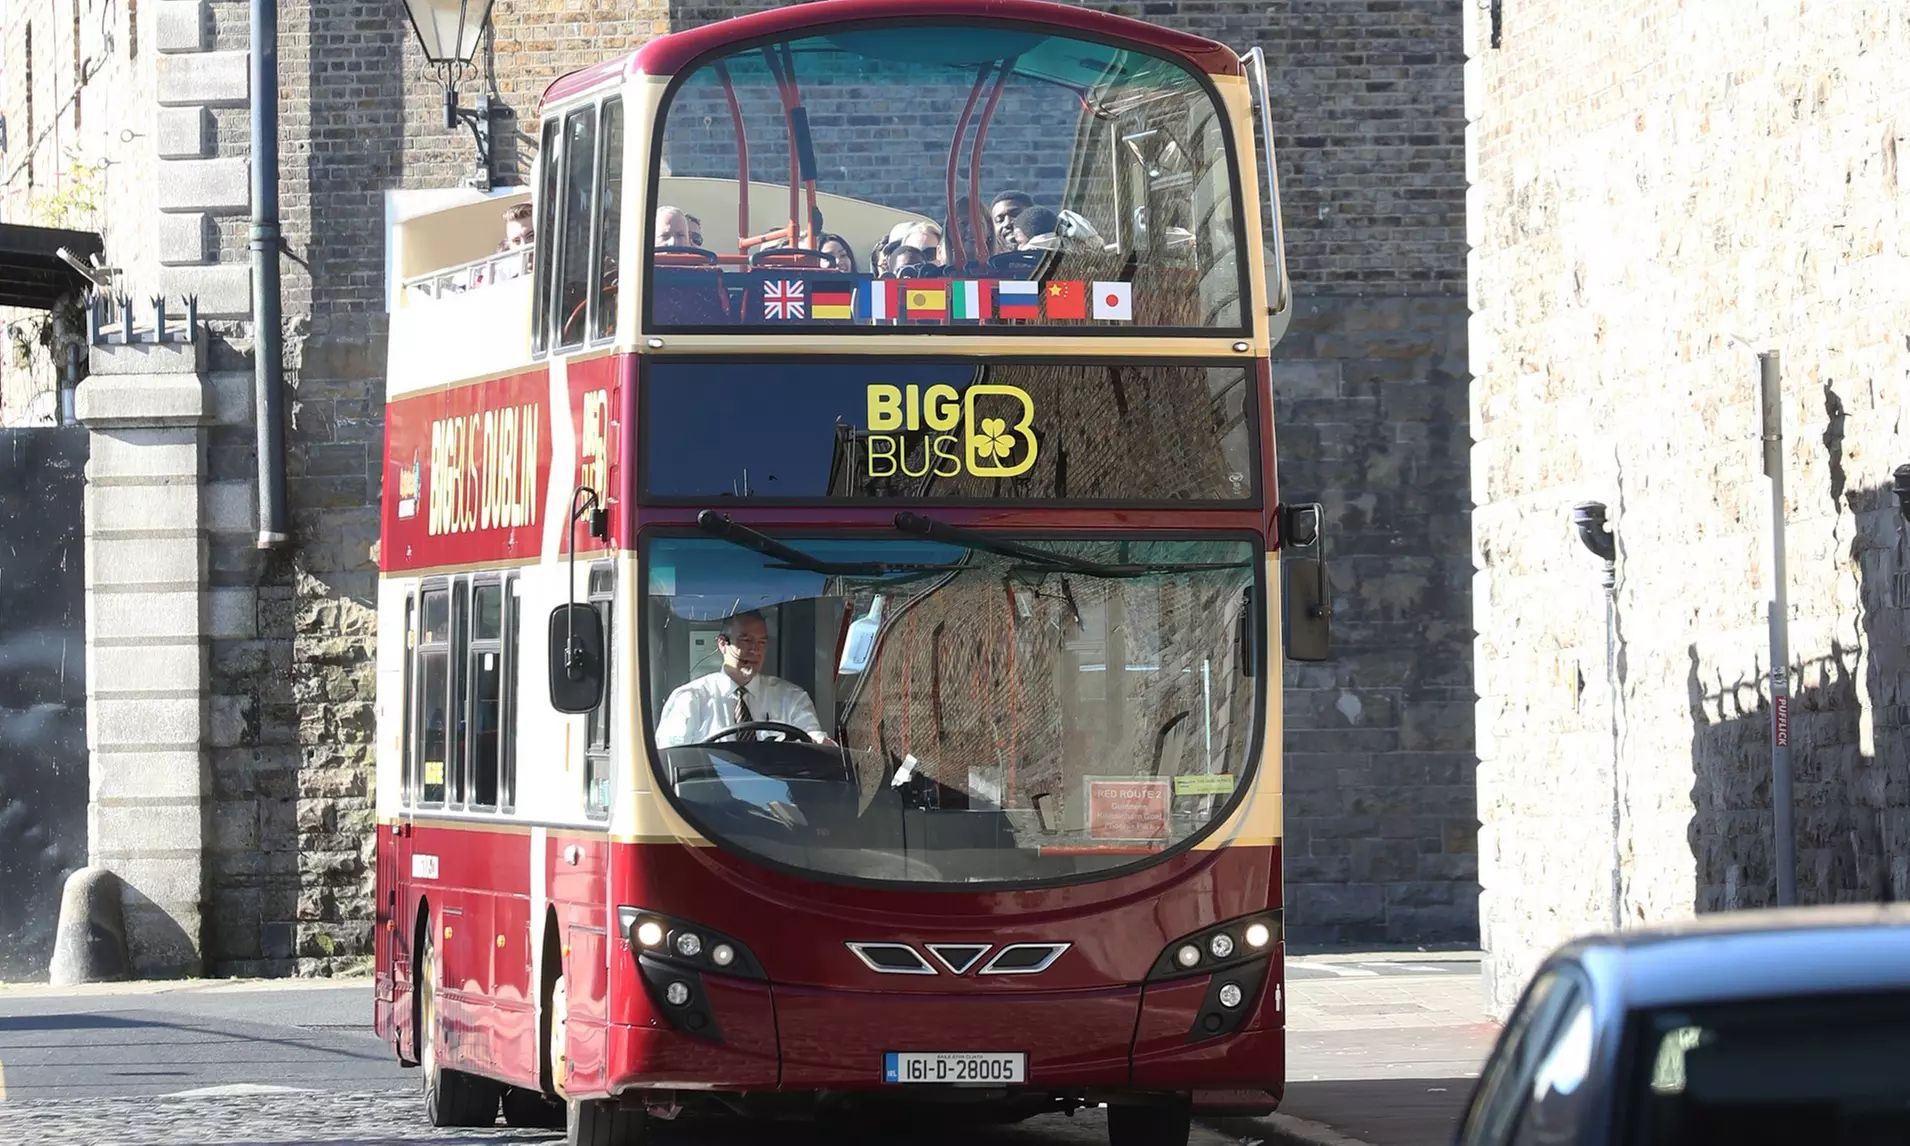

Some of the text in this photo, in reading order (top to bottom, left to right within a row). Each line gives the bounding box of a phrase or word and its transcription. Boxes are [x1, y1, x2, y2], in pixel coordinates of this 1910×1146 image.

[867, 384, 960, 431] BIG
[481, 402, 539, 530] DUBLIN
[867, 435, 961, 477] BUS
[1097, 789, 1162, 798] RED ROUTE 2
[906, 1059, 1014, 1080] 161-D-28005
